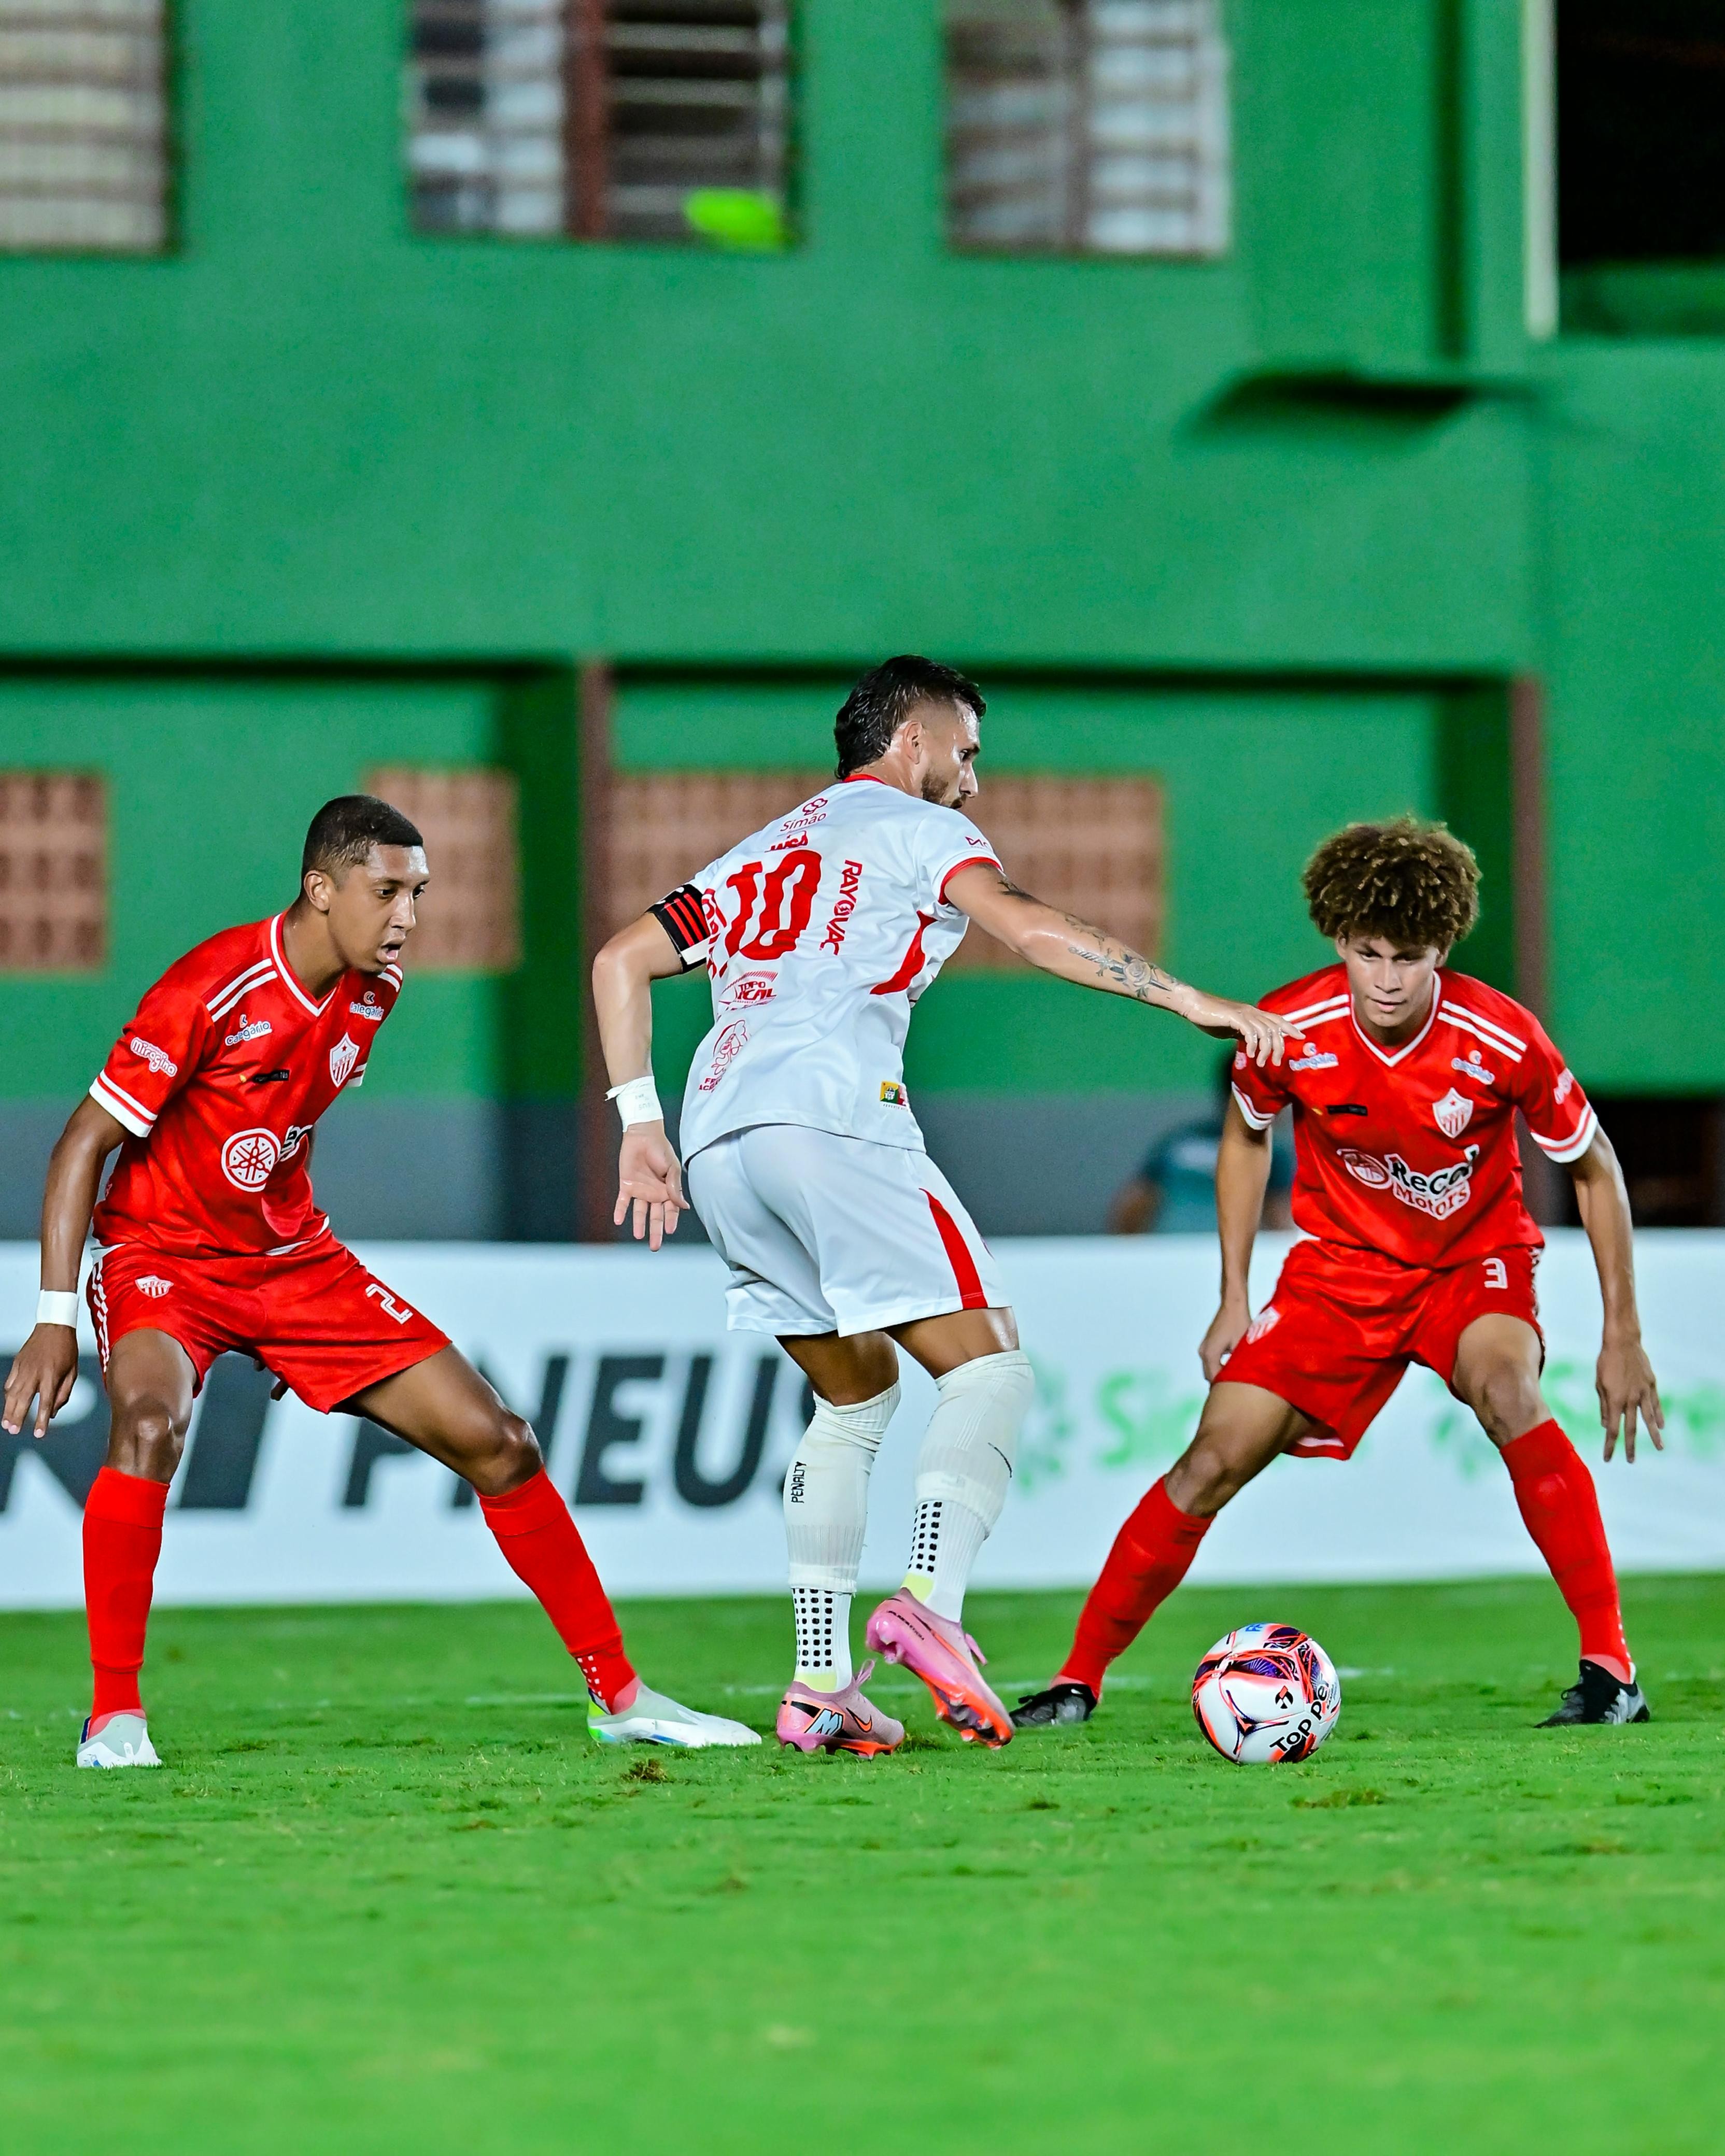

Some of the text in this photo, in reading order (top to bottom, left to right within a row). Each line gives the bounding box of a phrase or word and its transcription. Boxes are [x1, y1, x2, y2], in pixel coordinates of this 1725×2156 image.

[780, 813, 827, 832] Simão
[725, 849, 823, 961] 10
[818, 859, 863, 956] RAYOVAC
[132, 1038, 176, 1076] Miragina
[1481, 1257, 1508, 1289] 3
[365, 1283, 414, 1325] 2
[790, 1461, 807, 1503] PENALTY
